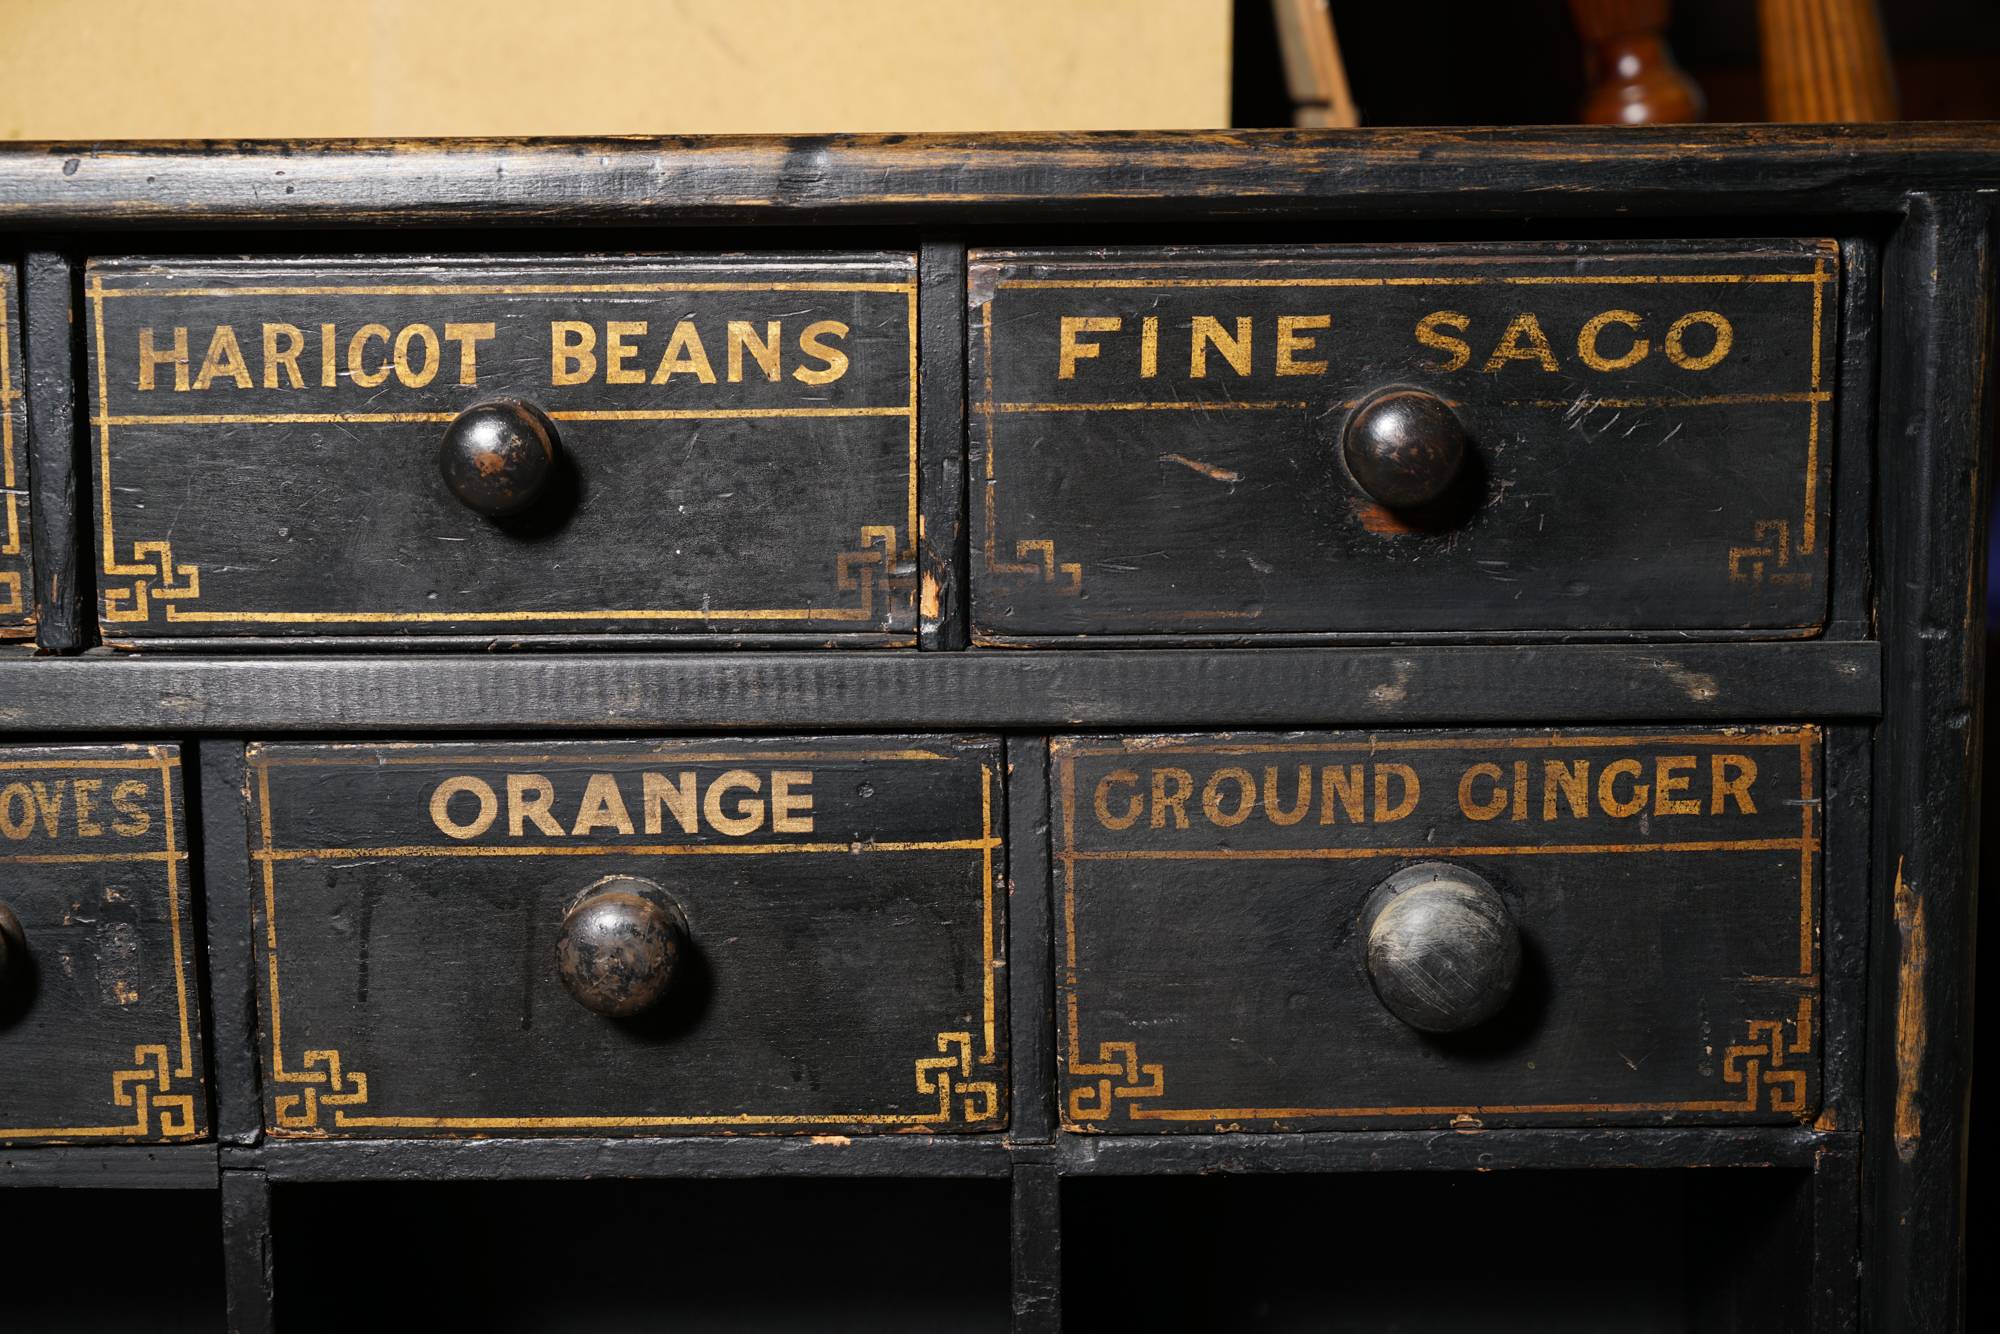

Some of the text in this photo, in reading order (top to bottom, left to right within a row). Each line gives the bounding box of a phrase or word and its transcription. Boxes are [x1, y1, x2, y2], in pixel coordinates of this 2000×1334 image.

[138, 320, 850, 392] HARICOT BEANS
[1058, 309, 1734, 380] FINE SAGO
[0, 778, 151, 841] OVES
[429, 769, 814, 839] ORANGE
[1094, 754, 1759, 830] GROUND GINGER
